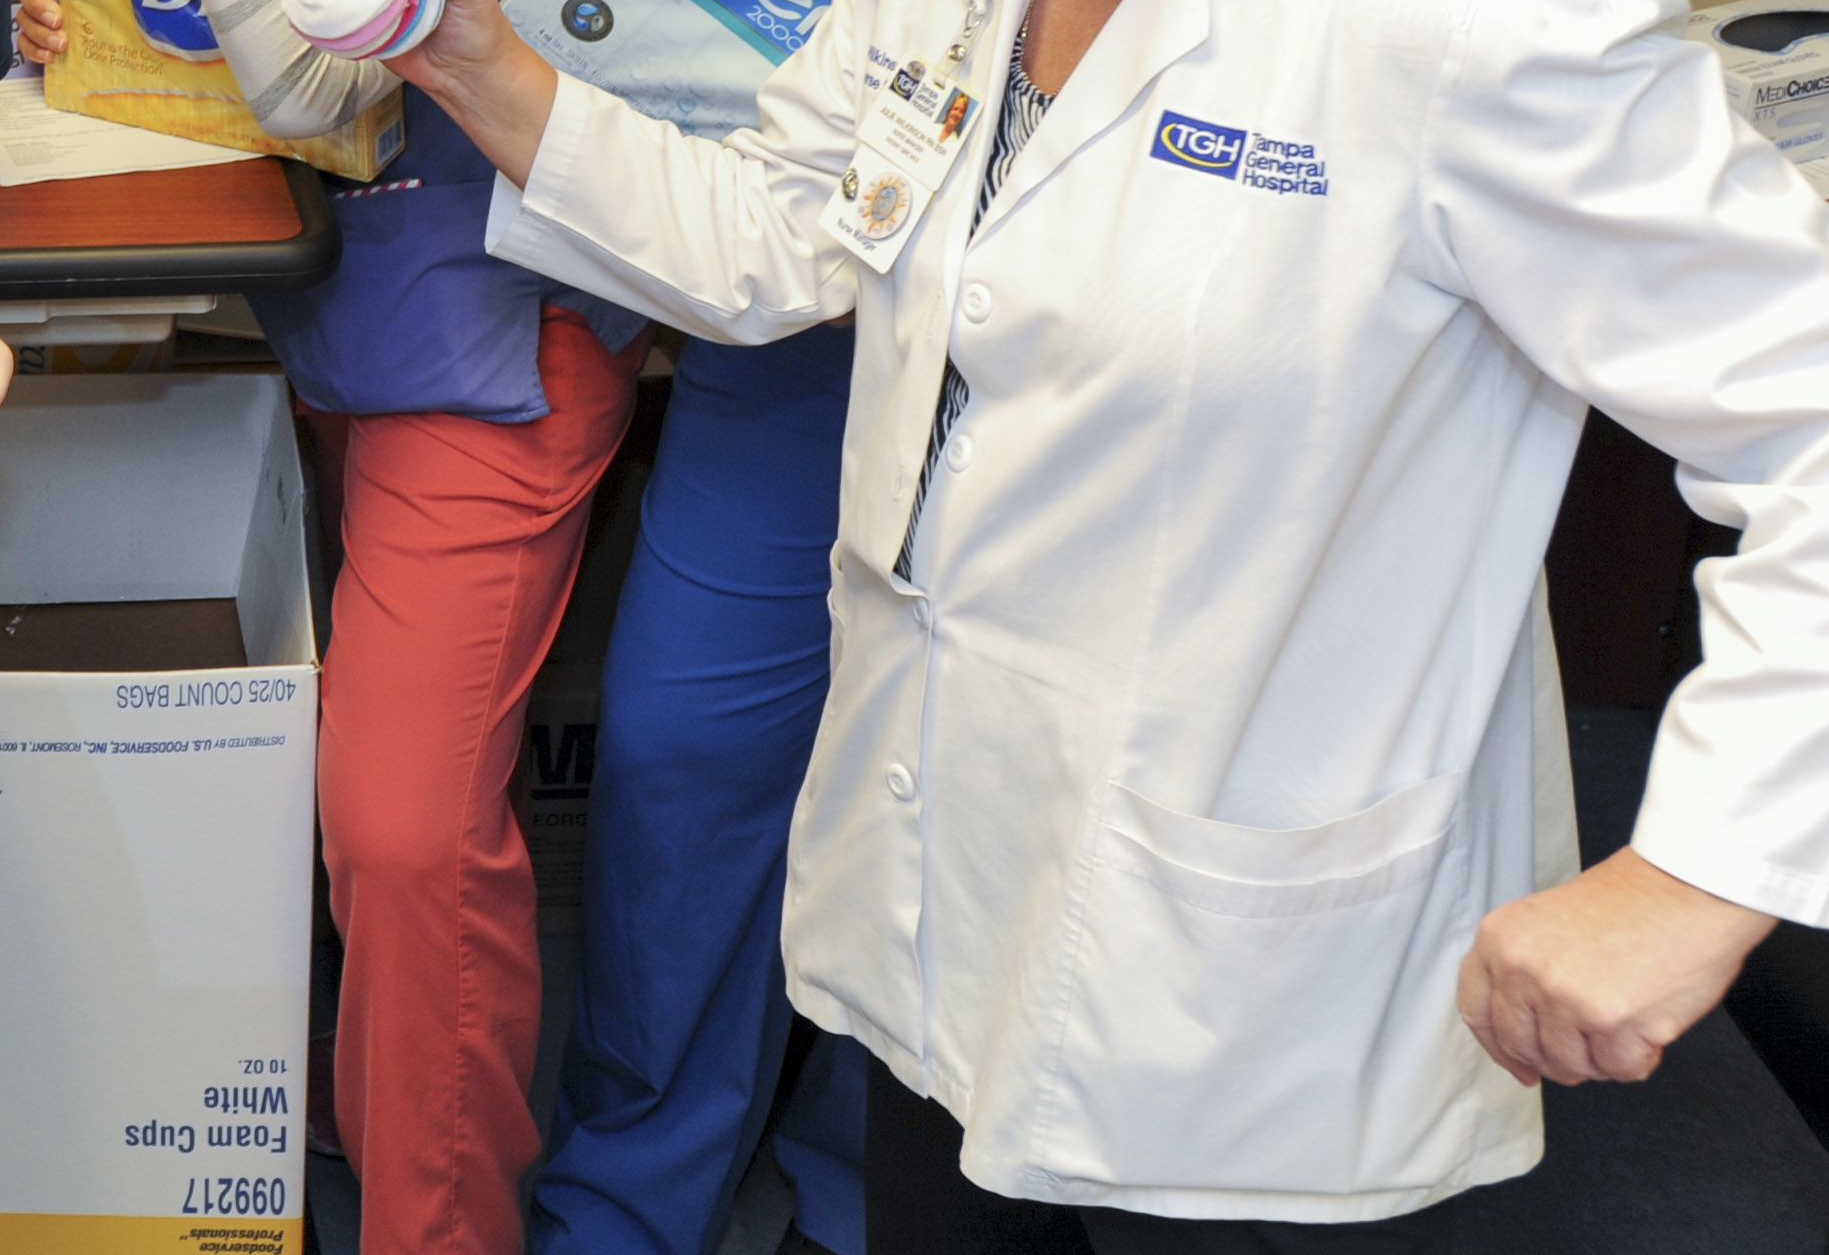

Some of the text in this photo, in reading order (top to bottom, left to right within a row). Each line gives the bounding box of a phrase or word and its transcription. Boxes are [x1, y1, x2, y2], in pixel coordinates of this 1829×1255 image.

[1174, 122, 1242, 164] TGH
[1251, 132, 1316, 160] Tampa
[1245, 151, 1326, 178] General
[1242, 168, 1329, 197] Hospital
[116, 678, 297, 710] 40/25 COUNT BAGS
[193, 739, 214, 753] U.S.
[213, 737, 228, 750] BY
[227, 735, 287, 748] DISTRIBUTED
[238, 1058, 288, 1075] 10 OZ.
[203, 1086, 289, 1115] White
[124, 1119, 288, 1154] Foam Cups
[182, 1177, 286, 1216] 099217
[199, 1242, 284, 1255] Foodservice
